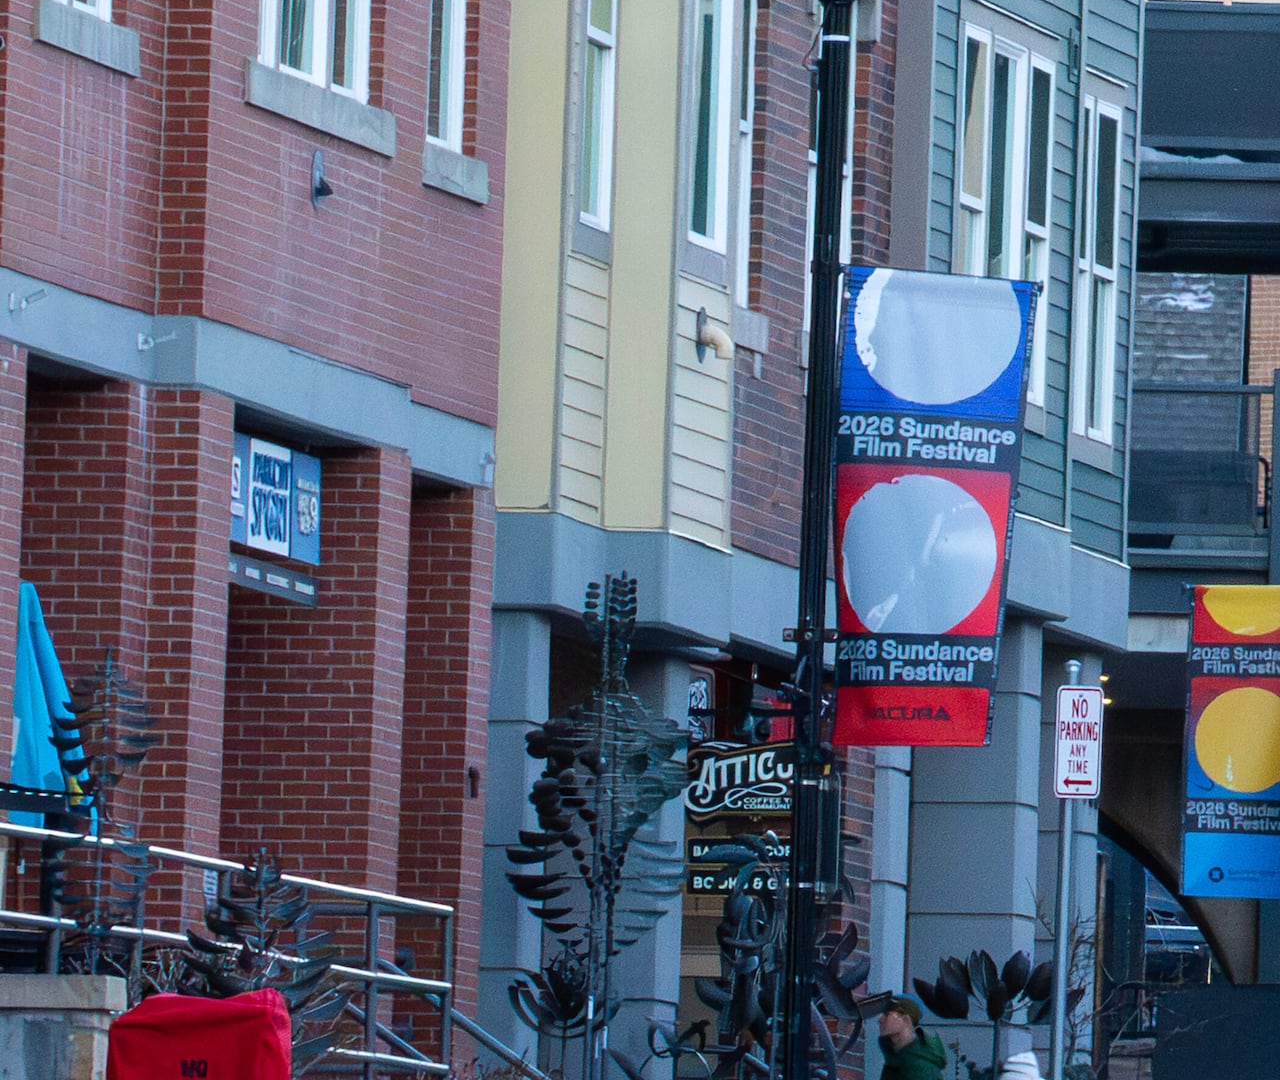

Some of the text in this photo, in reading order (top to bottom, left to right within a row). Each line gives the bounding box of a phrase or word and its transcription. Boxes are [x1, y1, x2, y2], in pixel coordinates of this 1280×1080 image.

[838, 416, 1016, 446] 2026 Sundance
[853, 436, 997, 464] Film Festival
[838, 639, 994, 662] 2026 Sundance
[1192, 647, 1230, 661] 2026
[850, 661, 974, 683] Film Festival
[1203, 660, 1236, 674] Film
[1071, 698, 1089, 718] NO
[1060, 720, 1099, 742] PARKING
[1070, 743, 1088, 758] ANY
[695, 751, 794, 796] ATTICU
[1067, 760, 1089, 775] TIME
[1186, 801, 1225, 816] 2026
[1197, 816, 1230, 830] Film
